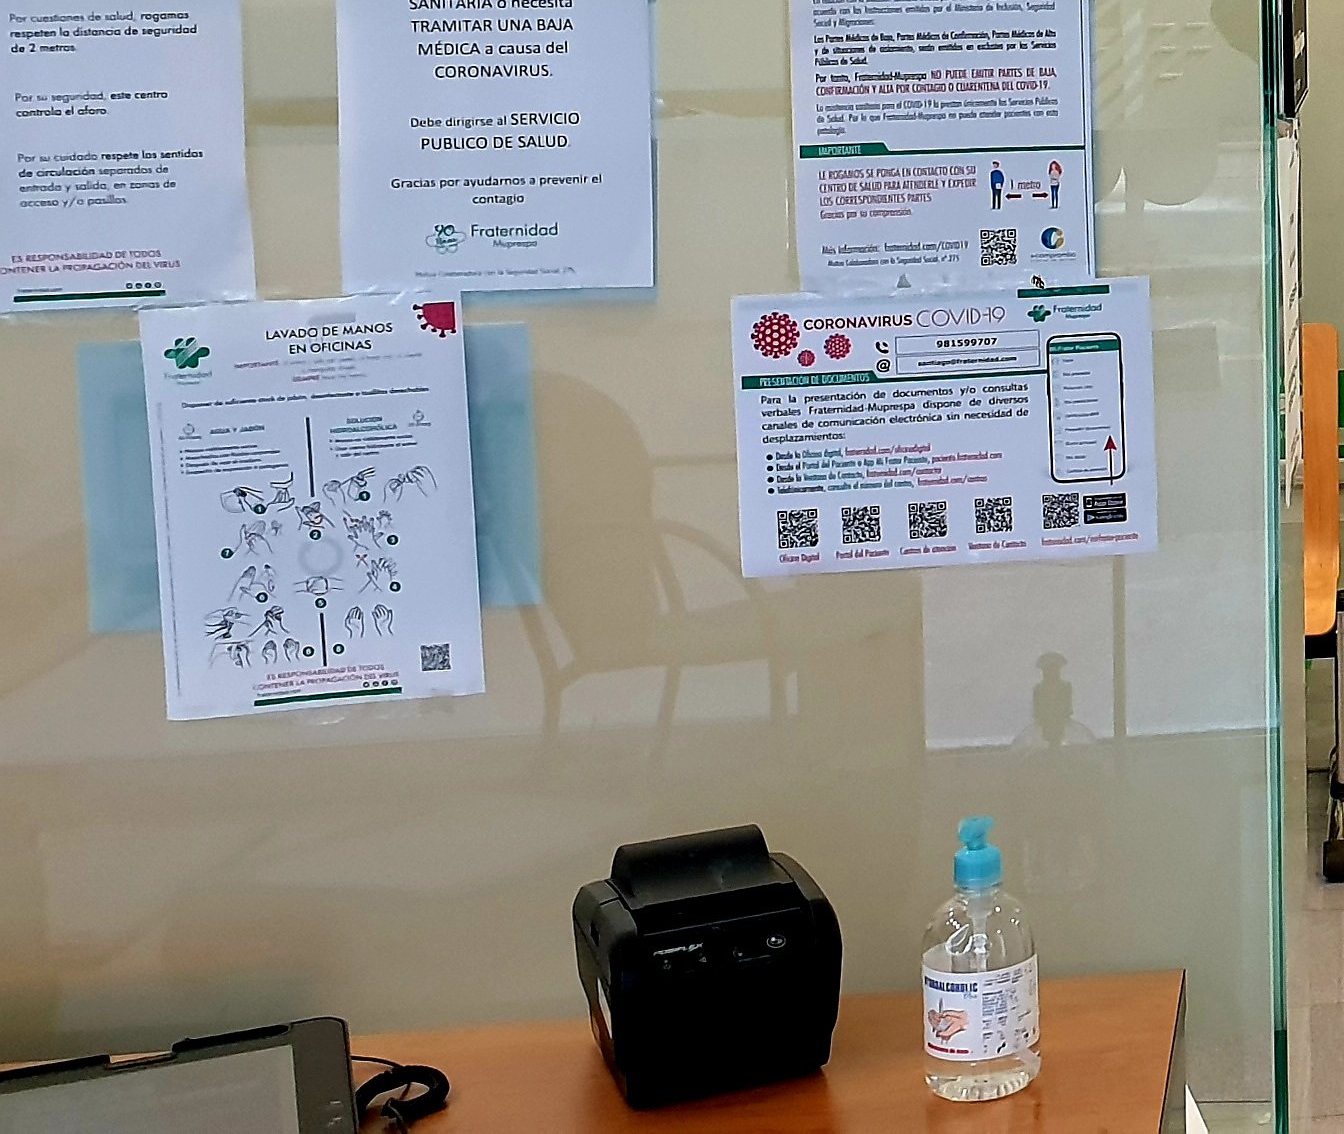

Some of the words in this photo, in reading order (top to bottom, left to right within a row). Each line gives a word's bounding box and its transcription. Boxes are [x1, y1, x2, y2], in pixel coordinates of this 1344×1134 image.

[497, 0, 506, 8] o
[411, 20, 492, 33] TRAMITAR
[498, 19, 532, 31] UNA
[537, 18, 573, 31] BAJA
[418, 40, 481, 55] MÉDICA
[485, 45, 493, 54] a
[498, 45, 540, 54] causa
[546, 40, 568, 54] del
[435, 64, 553, 78] CORONAVIRUS.
[411, 117, 442, 127] Debe
[445, 117, 493, 129] dirigirse
[497, 115, 507, 126] al
[511, 112, 579, 125] SERVICIO
[421, 137, 487, 150] PUBLICO
[493, 136, 513, 148] DE
[391, 179, 436, 188] Gracias
[440, 179, 460, 189] por
[463, 176, 526, 187] ayudarnos
[529, 177, 536, 185] a
[539, 175, 588, 186] prevenir
[592, 174, 602, 183] el
[472, 194, 524, 205] contagio
[471, 222, 558, 237] Fraternidad
[804, 315, 912, 330] CORONAVIRUS
[916, 306, 1005, 327] COVID-19
[266, 328, 318, 340] LAVADO
[322, 326, 338, 336] DE
[343, 322, 393, 335] MANOS
[289, 344, 306, 354] EN
[310, 340, 372, 353] OFICINAS
[936, 338, 997, 348] 981599707
[761, 395, 781, 404] Para
[788, 394, 797, 403] la
[804, 392, 866, 404] presentación
[873, 390, 886, 399] de
[892, 388, 953, 398] documentos
[960, 386, 976, 396] y/o
[982, 383, 1028, 393] consultas
[761, 408, 801, 417] verbales
[809, 403, 915, 415] Fraternidad-Muprespa
[923, 400, 962, 410] dispone
[969, 398, 982, 406] de
[988, 397, 1029, 405] diversos
[762, 421, 798, 430] canales
[802, 420, 814, 428] de
[818, 416, 885, 428] comunicación
[889, 413, 942, 424] electrónica
[964, 408, 1012, 419] necesidad
[1016, 408, 1029, 416] de
[762, 433, 846, 444] desplazamientos:
